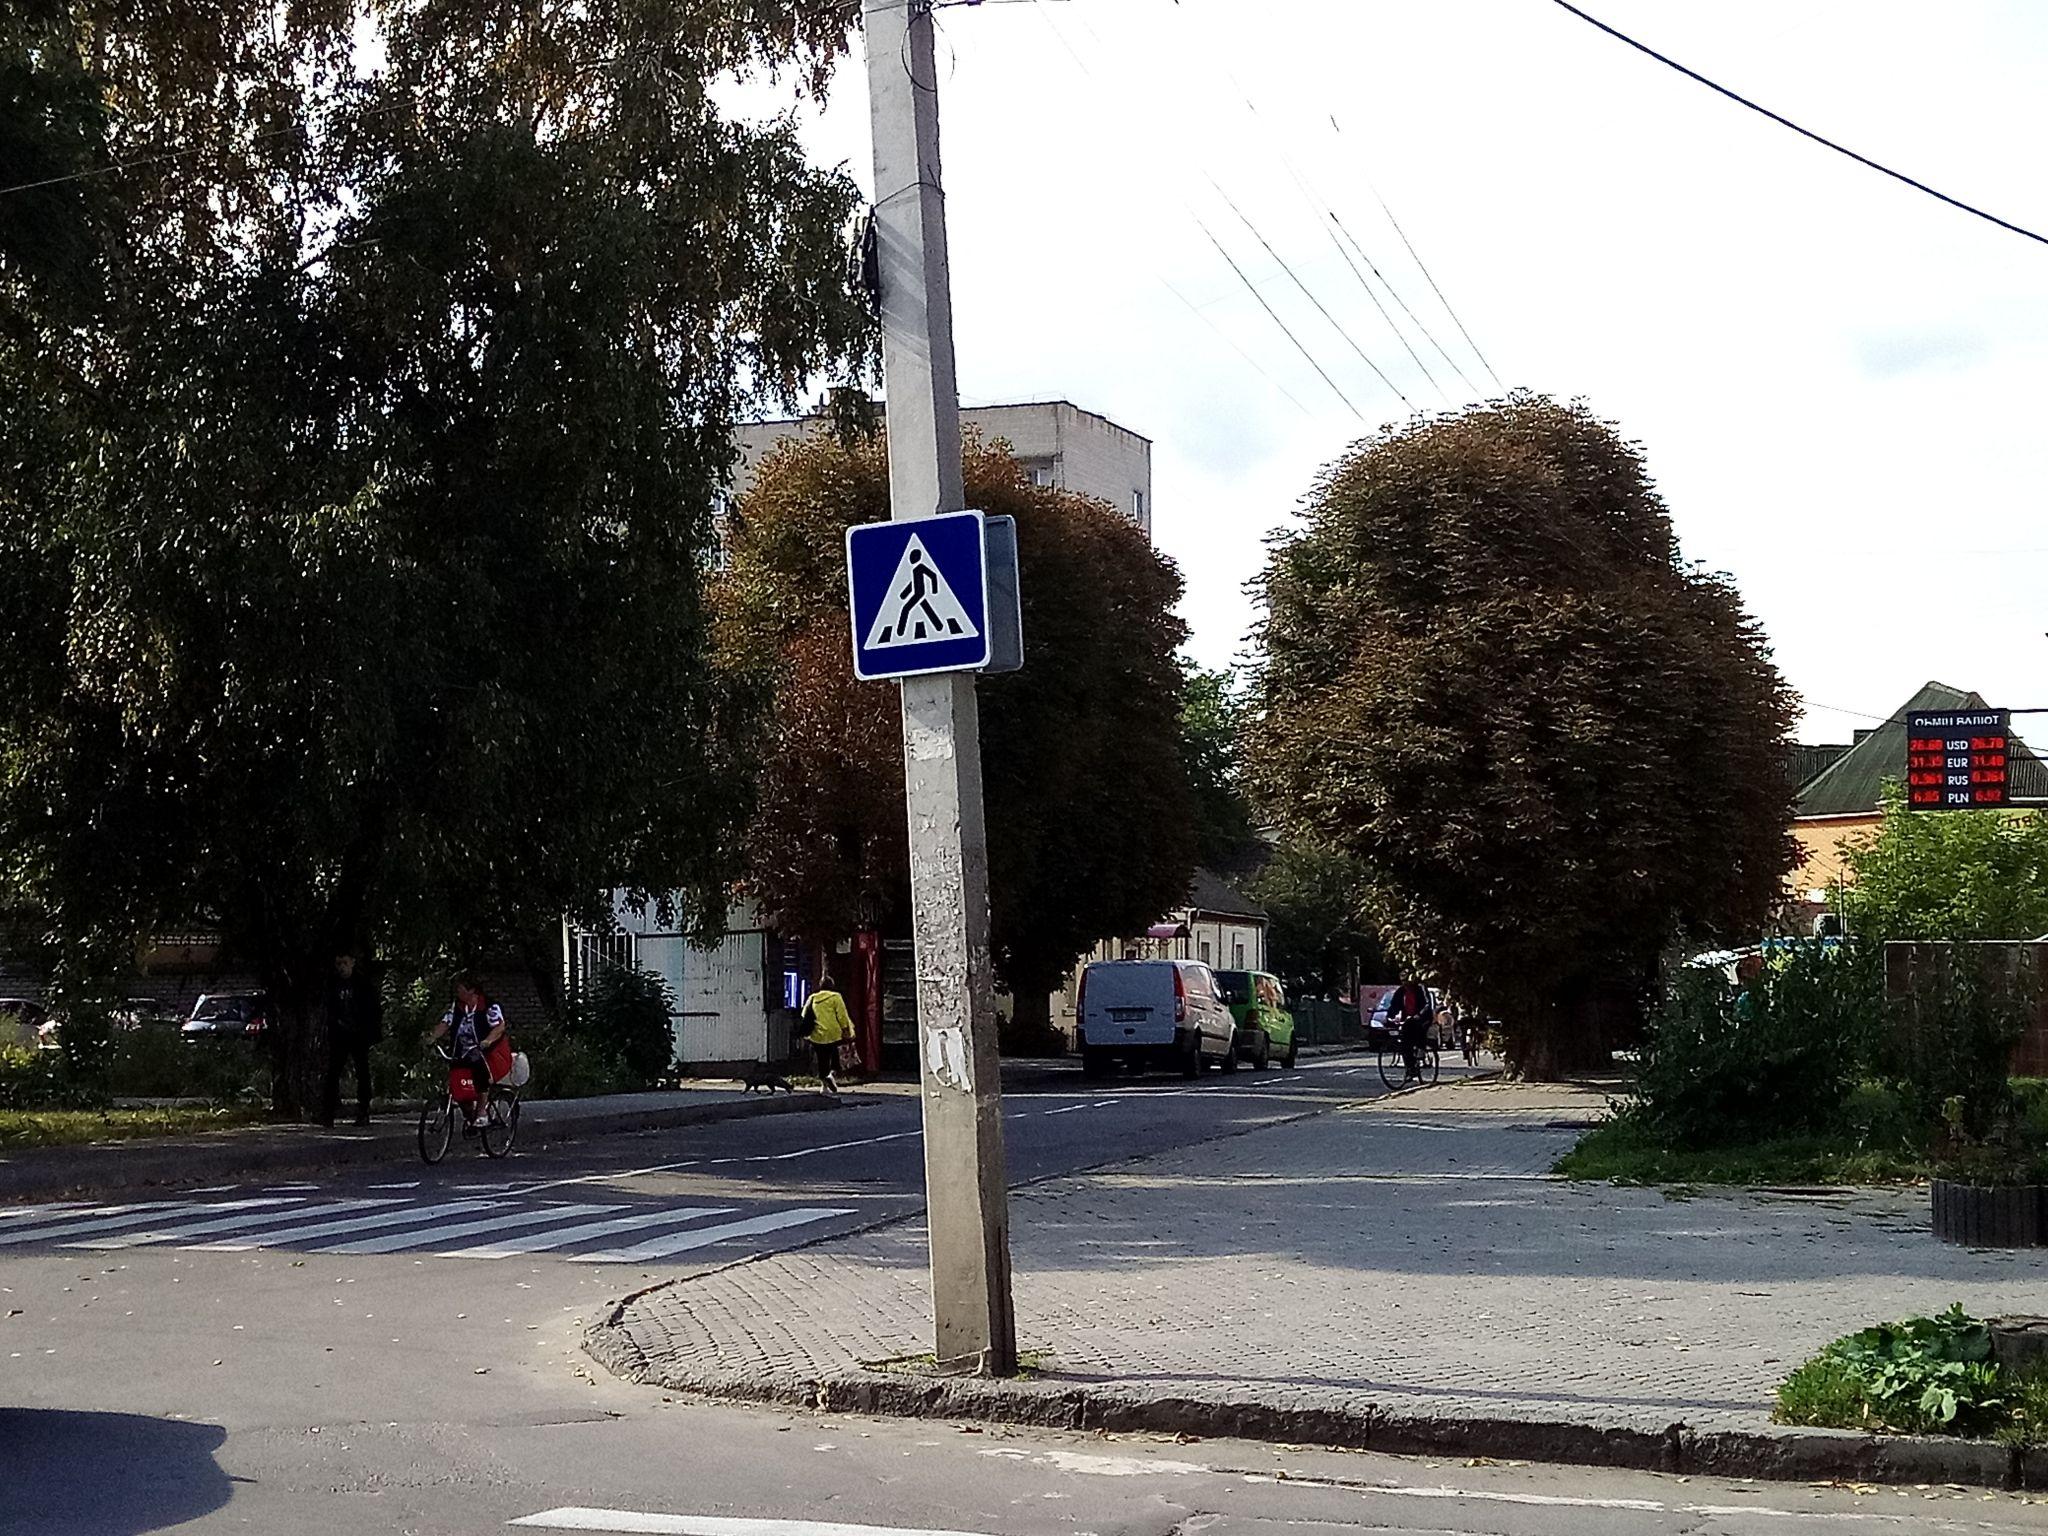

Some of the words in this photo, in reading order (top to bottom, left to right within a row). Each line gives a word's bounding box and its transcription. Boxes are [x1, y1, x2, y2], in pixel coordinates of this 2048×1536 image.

[1946, 740, 1968, 750] USD
[1947, 758, 1968, 768] EUR
[1948, 776, 1968, 785] RUS
[1948, 793, 1969, 803] PLN
